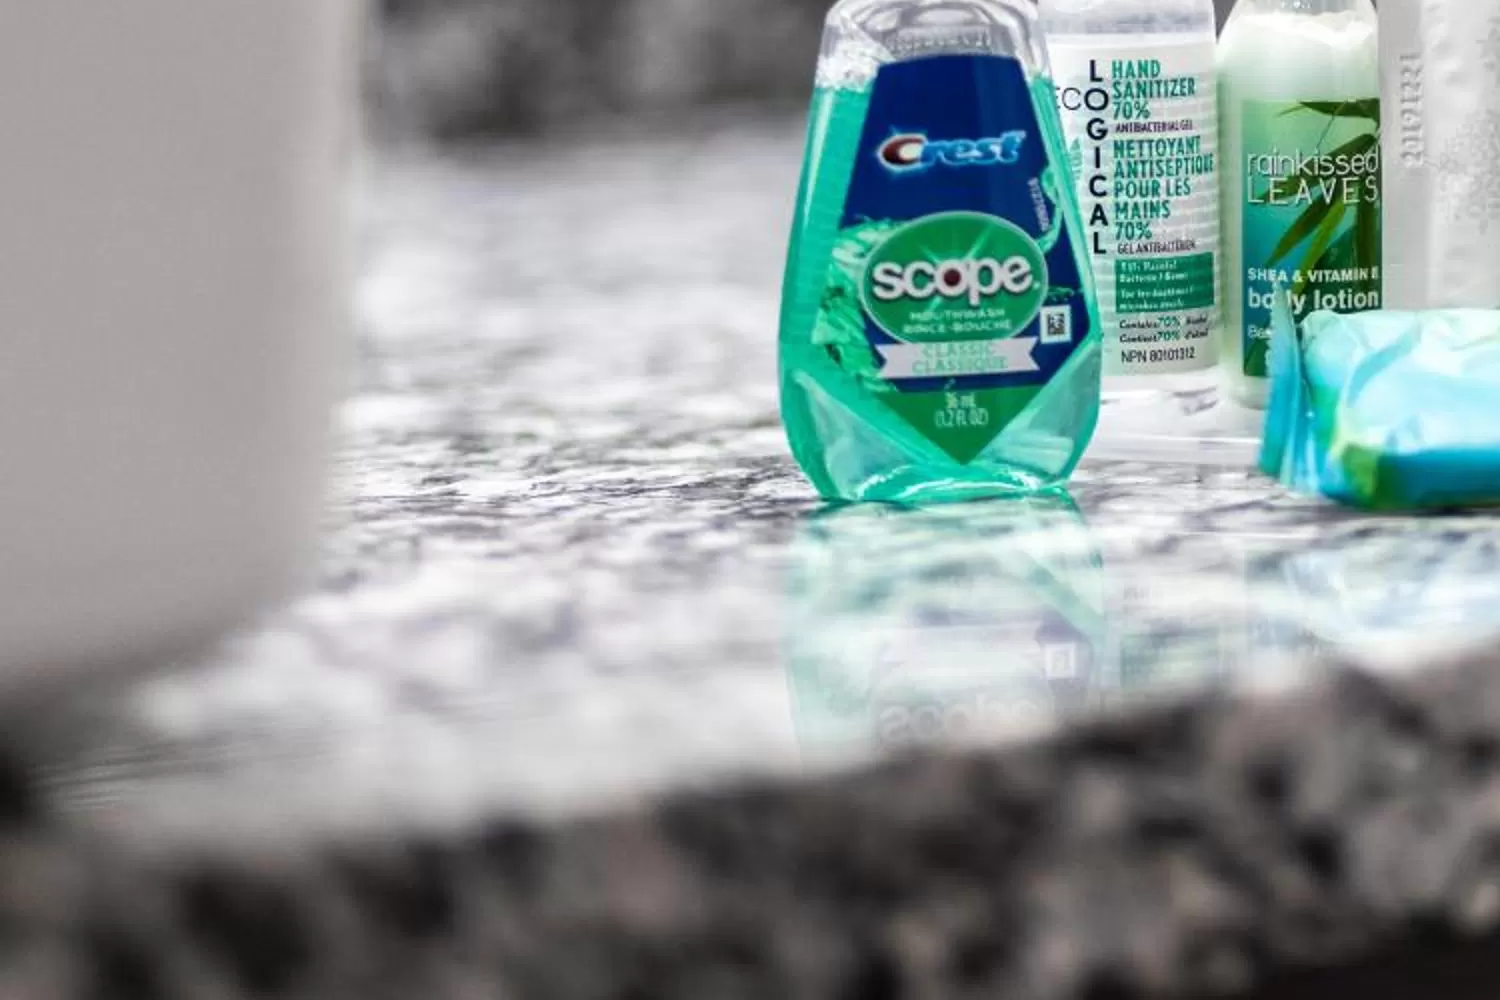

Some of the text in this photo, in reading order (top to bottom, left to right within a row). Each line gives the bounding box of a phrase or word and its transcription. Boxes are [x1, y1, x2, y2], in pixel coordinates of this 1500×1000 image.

[1112, 59, 1161, 79] HAND
[1112, 77, 1196, 100] SANITIZER
[1113, 102, 1151, 120] 70%
[875, 129, 1028, 172] Crest
[1113, 135, 1201, 159] NETTOYANT
[1113, 153, 1214, 180] ANTISEPTIQUE
[1247, 144, 1379, 177] rainkissed
[1114, 177, 1191, 199] POUR LES
[1247, 176, 1379, 205] LEAVES
[1114, 200, 1171, 220] MAINS
[1115, 221, 1153, 241] 70%
[1118, 243, 1134, 255] GEL
[871, 254, 1034, 307] scope
[1247, 267, 1289, 283] SHEA
[1292, 270, 1304, 283] &
[1307, 267, 1369, 283] VITAMIN
[1313, 289, 1379, 310] lotion
[1121, 349, 1147, 363] NPN
